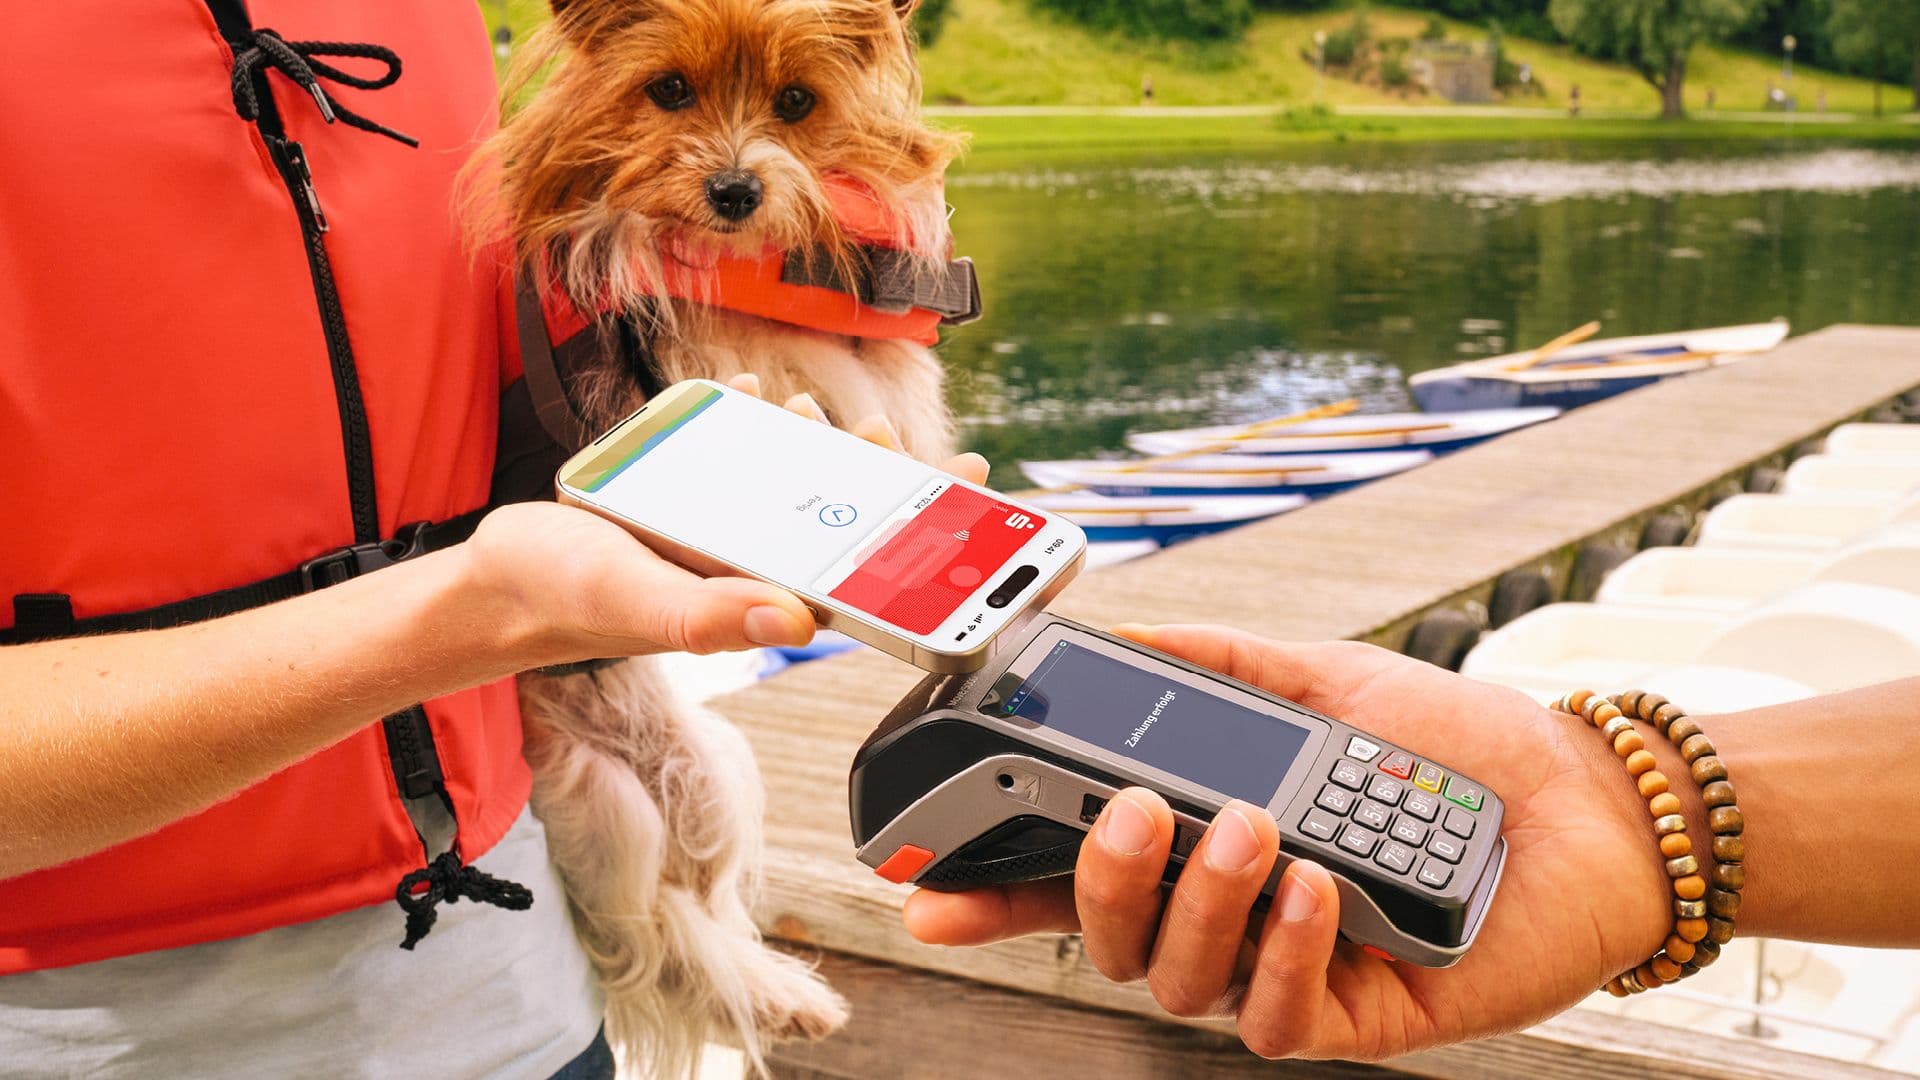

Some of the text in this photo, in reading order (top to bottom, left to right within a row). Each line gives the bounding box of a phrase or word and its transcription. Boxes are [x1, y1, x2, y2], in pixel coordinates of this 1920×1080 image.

[1124, 690, 1176, 748] Zahlung erfolgt
[1338, 772, 1356, 782] 3
[1377, 787, 1394, 798] 6
[1325, 796, 1344, 808] 2
[1410, 801, 1428, 813] 9
[1363, 809, 1382, 821] 5
[1310, 821, 1328, 831] 1
[1398, 826, 1416, 839] 8
[1347, 835, 1366, 847] 4
[1384, 852, 1402, 865] 7
[1423, 869, 1440, 882] F
